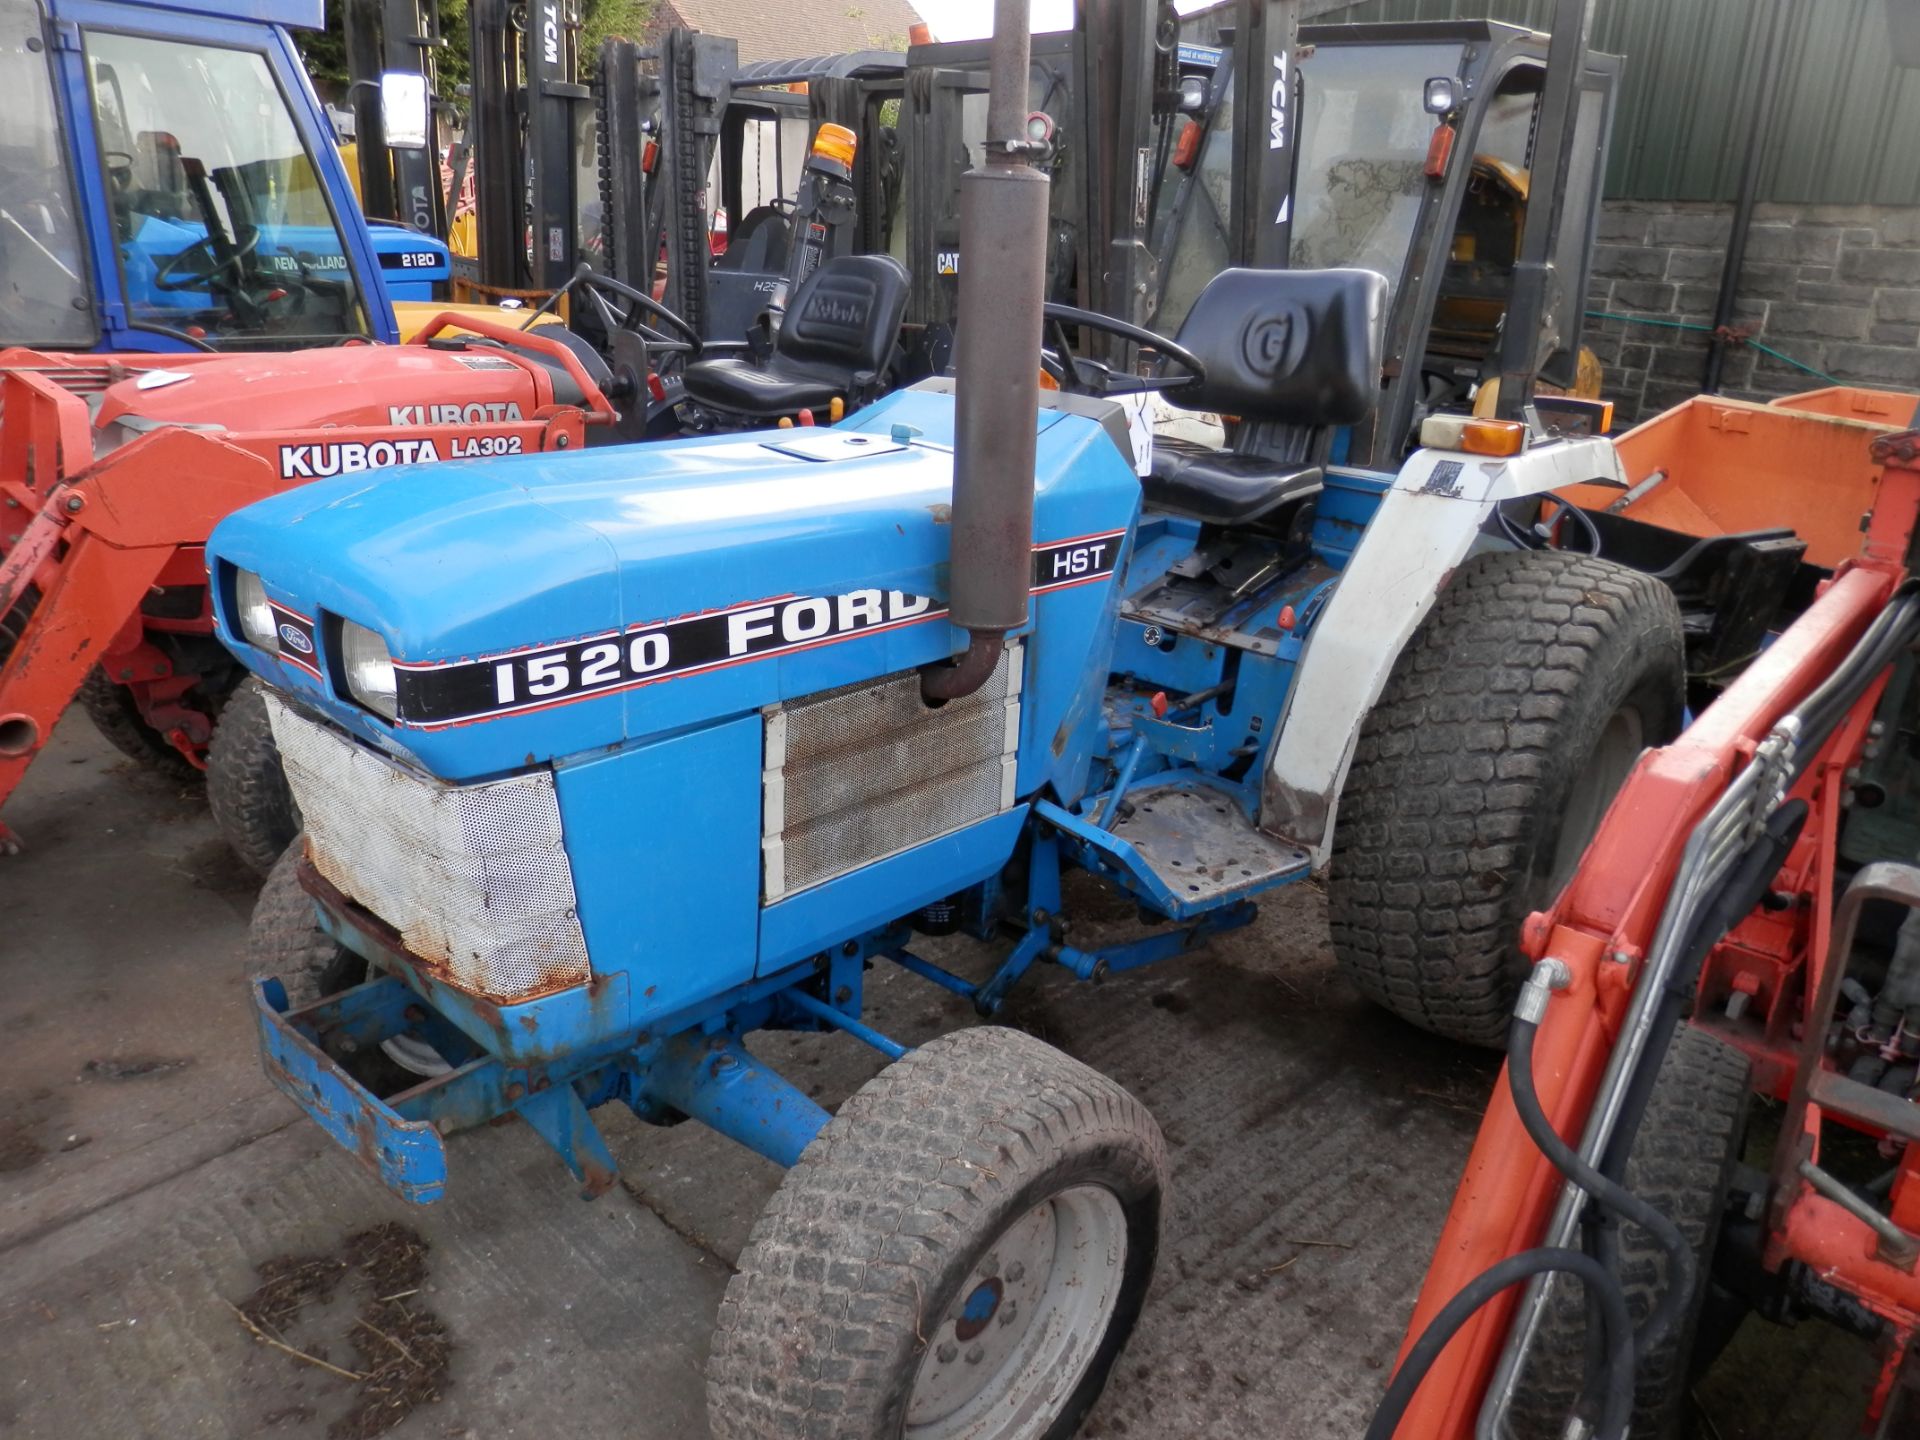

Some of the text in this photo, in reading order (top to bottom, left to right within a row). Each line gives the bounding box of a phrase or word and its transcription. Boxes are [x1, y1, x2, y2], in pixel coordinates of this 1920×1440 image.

[543, 5, 558, 64] TCM
[1270, 50, 1287, 149] TCM
[412, 186, 430, 230] OTA
[274, 255, 298, 270] NEW
[402, 253, 436, 267] 2120
[937, 253, 960, 274] CAT
[388, 402, 524, 427] KUBOTA
[280, 436, 523, 478] KUBOTA LA302
[1053, 543, 1106, 578] HST
[495, 588, 930, 705] 1520 FORD
